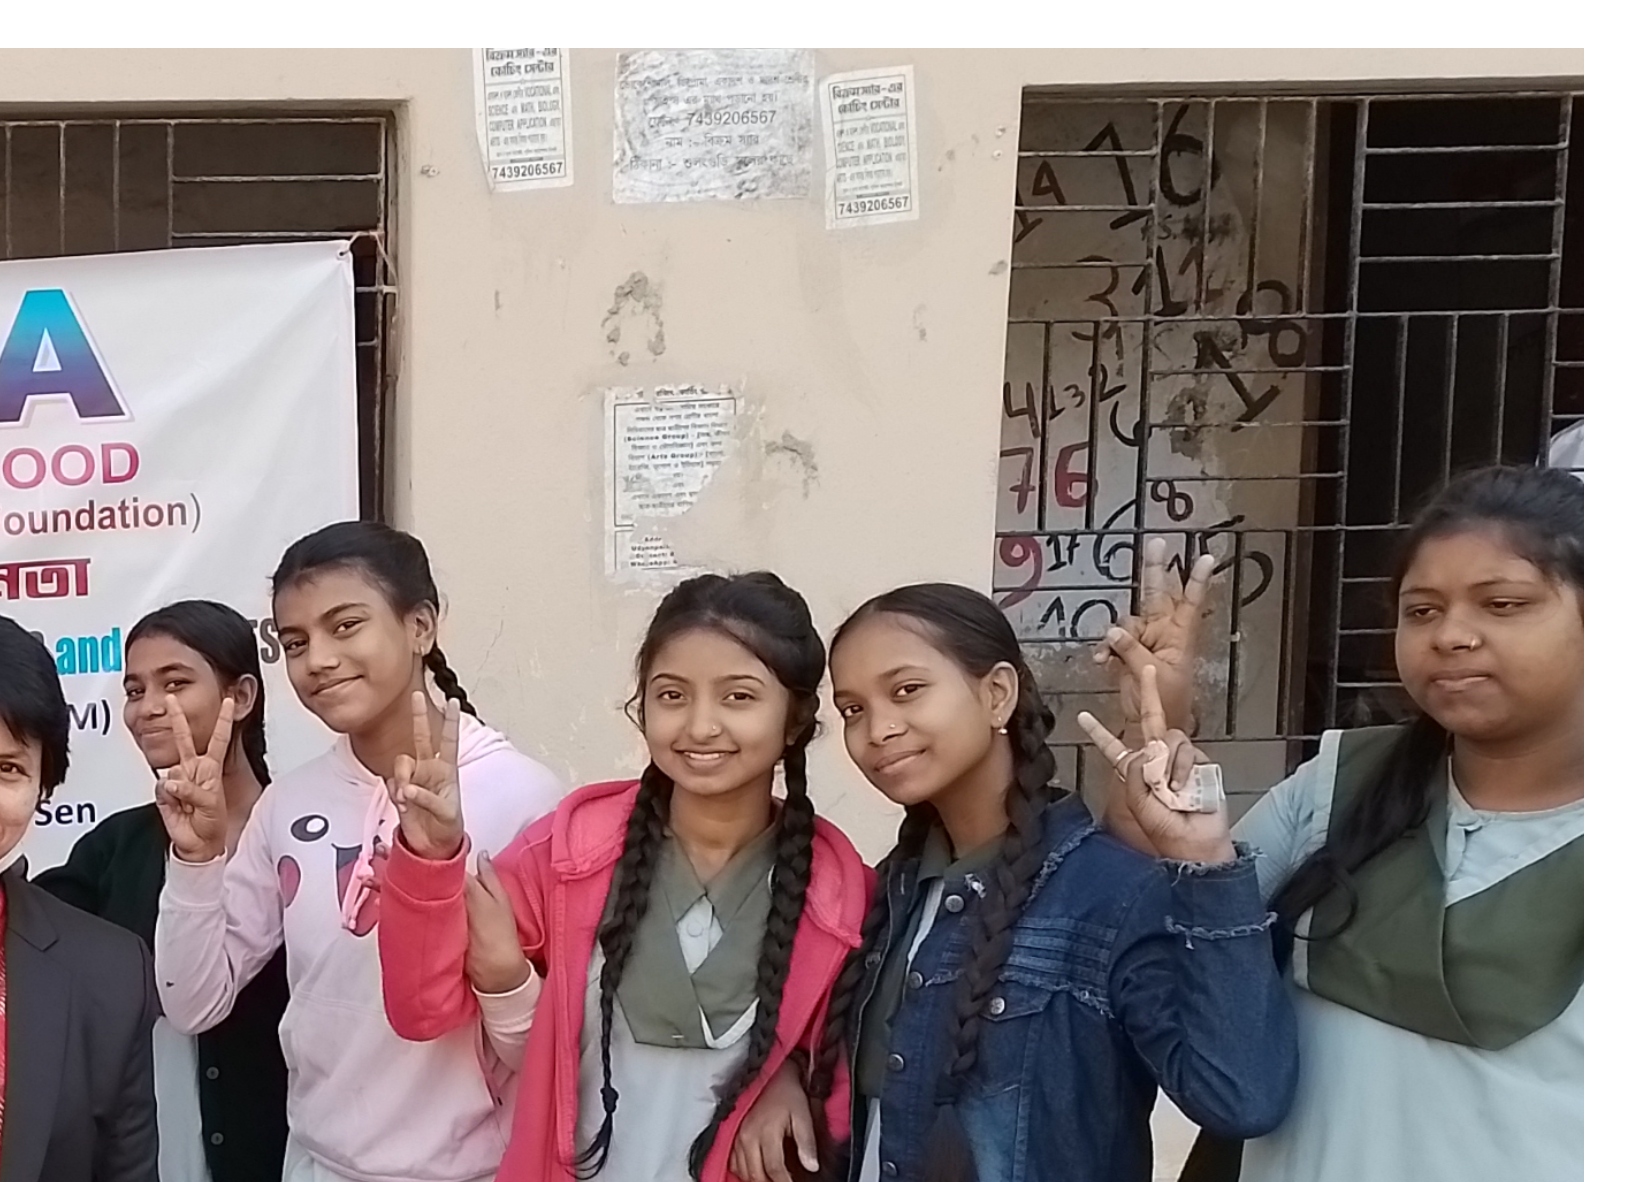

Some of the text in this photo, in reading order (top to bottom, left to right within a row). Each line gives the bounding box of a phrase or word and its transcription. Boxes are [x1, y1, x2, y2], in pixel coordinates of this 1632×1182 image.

[687, 110, 778, 126] 7439206567
[492, 161, 563, 179] 7439206567
[1083, 102, 1220, 231] 16
[838, 196, 909, 215] 7439206567
[1003, 381, 1041, 439] 4
[1054, 441, 1099, 508] 6
[1150, 480, 1194, 522] 8
[998, 534, 1043, 610] 9
[55, 627, 123, 676] and
[35, 800, 97, 826] Sen
